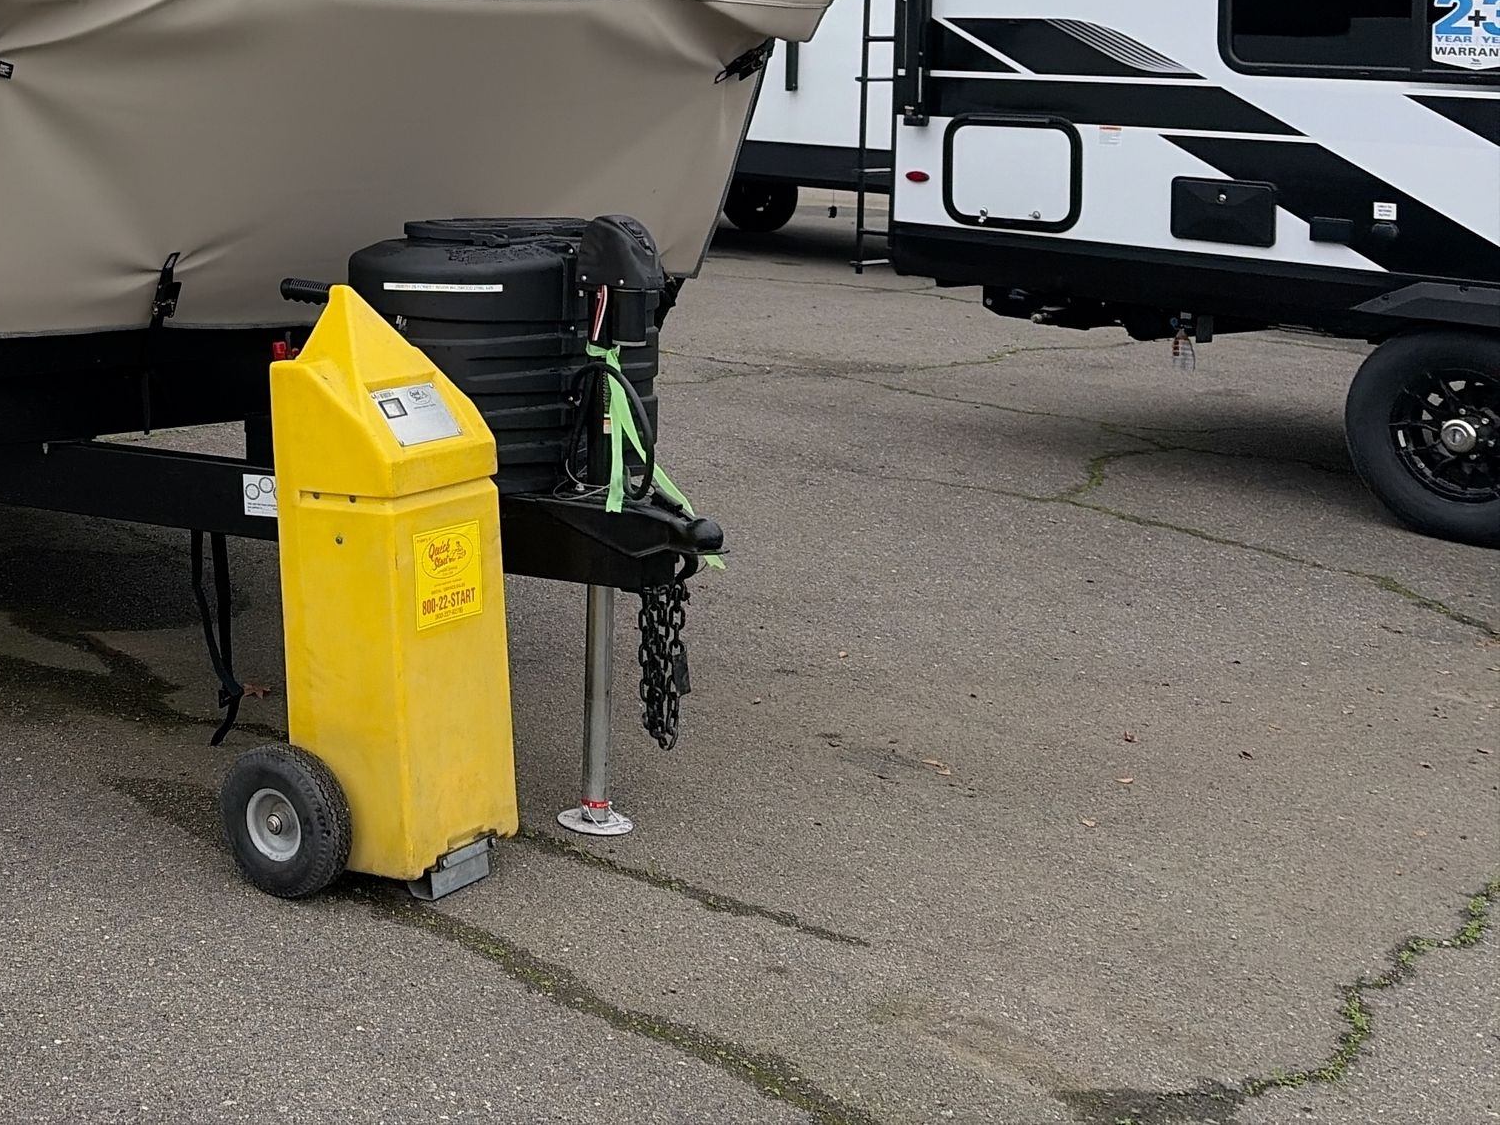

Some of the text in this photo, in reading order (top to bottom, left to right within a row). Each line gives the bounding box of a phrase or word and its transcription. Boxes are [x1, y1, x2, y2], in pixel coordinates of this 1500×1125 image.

[1435, 35, 1472, 43] YEAR
[1435, 46, 1500, 57] WARRAN
[428, 538, 450, 562] Quick
[422, 587, 476, 616] 800-22-START
